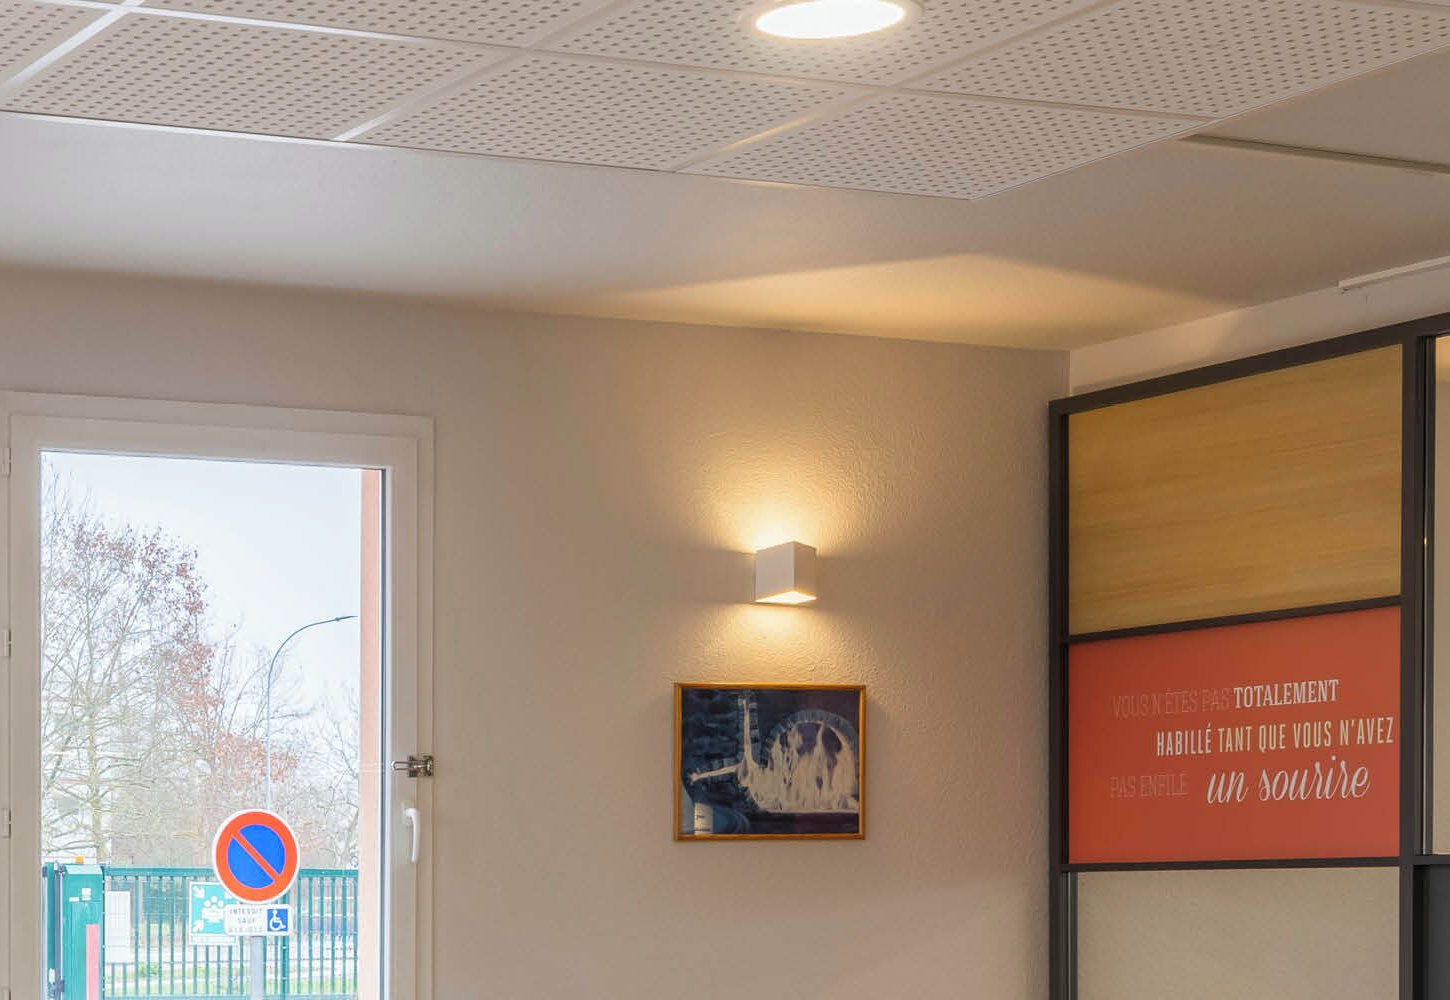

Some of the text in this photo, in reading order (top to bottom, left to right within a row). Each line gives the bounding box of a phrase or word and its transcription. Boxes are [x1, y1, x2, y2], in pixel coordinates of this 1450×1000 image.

[1202, 688, 1230, 712] PAS
[1233, 679, 1339, 709] TOTALEMENT
[1156, 716, 1394, 756] HABILLÉ TANT QUE VOUS N'AVEZ
[1110, 776, 1136, 798] PAS
[1206, 770, 1249, 804] un
[1258, 754, 1371, 802] sourire
